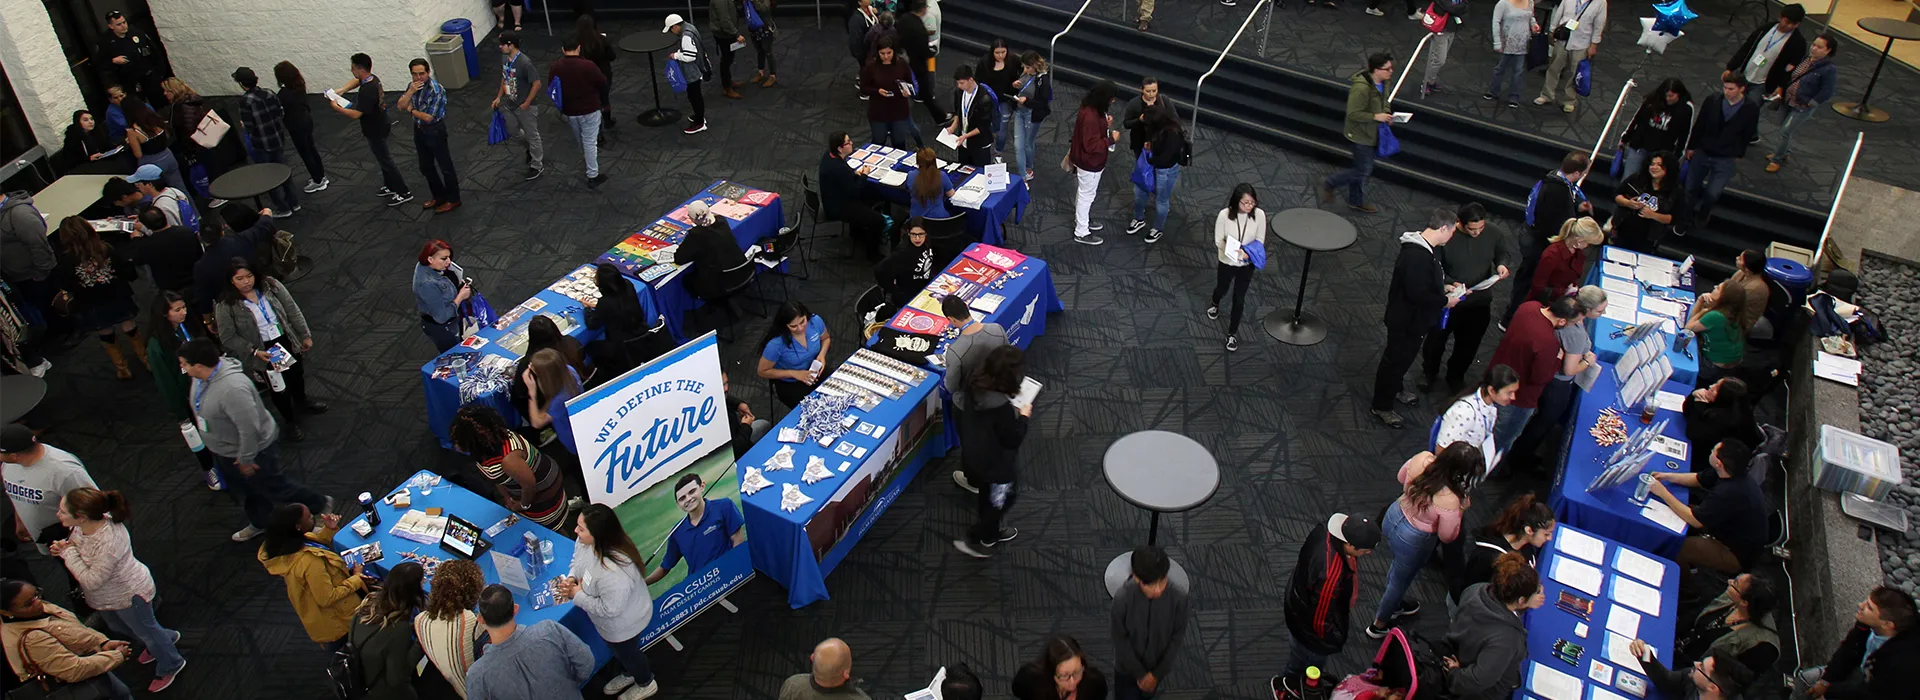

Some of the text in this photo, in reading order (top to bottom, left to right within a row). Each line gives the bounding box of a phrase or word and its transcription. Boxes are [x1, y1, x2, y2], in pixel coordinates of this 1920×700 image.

[594, 379, 704, 444] WE DEFINE THE
[593, 395, 717, 494] Future
[660, 576, 721, 618] PALM DESERT CAMPUS
[685, 567, 720, 594] CSUSB
[693, 572, 743, 611] pdc.csusb.edu
